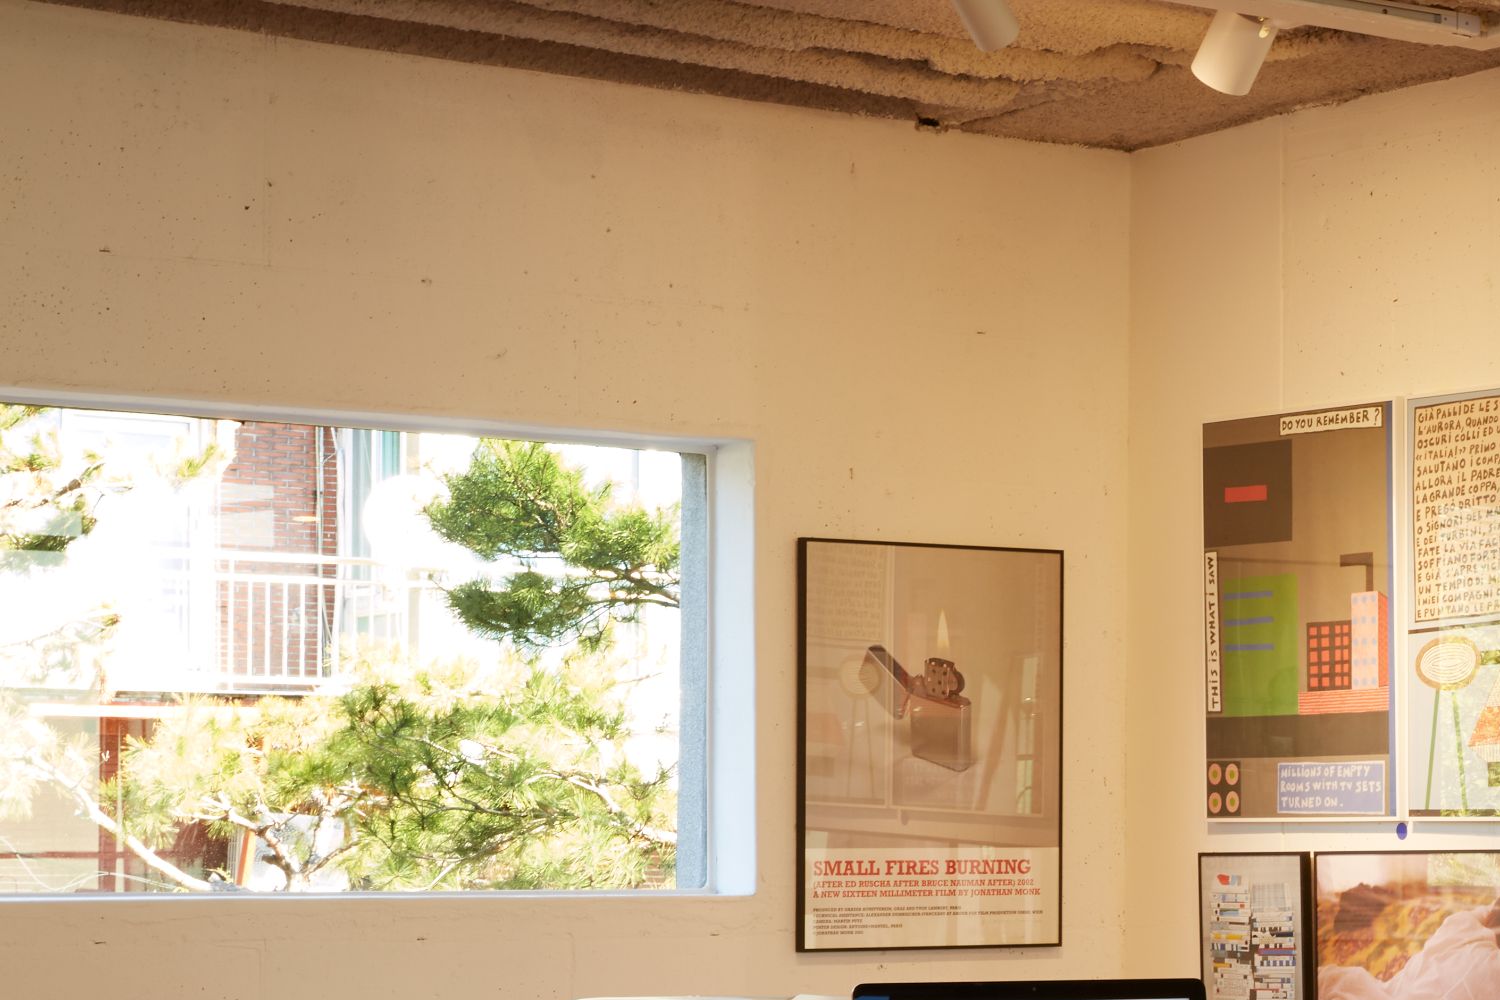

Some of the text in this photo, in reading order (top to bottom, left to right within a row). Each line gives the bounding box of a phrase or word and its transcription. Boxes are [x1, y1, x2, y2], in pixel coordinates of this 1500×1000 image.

[1282, 420, 1293, 431] DO
[1295, 418, 1313, 429] YOU
[1316, 410, 1370, 427] REMEMBER
[1207, 556, 1215, 585] SAW
[1208, 600, 1216, 645] WHAT
[1323, 766, 1335, 777] OF
[1337, 764, 1371, 777] EMPTY
[1280, 781, 1310, 792] ROOMS
[1312, 779, 1338, 790] WITH
[1355, 780, 1382, 792] SETS
[1281, 796, 1322, 808] TURNED
[813, 858, 1031, 876] SMALL FIRES BURNING
[845, 879, 857, 888] ED
[859, 879, 891, 888] RUSCHA
[893, 878, 919, 888] AFTER
[921, 878, 949, 888] BRUCE
[950, 878, 985, 888] NAUMAN
[987, 877, 1016, 888] AFTER)
[1017, 877, 1034, 887] 2002
[813, 887, 1041, 899] A NEW SIXTEEN MILLIMETER FILM BY JONATHAN MONK
